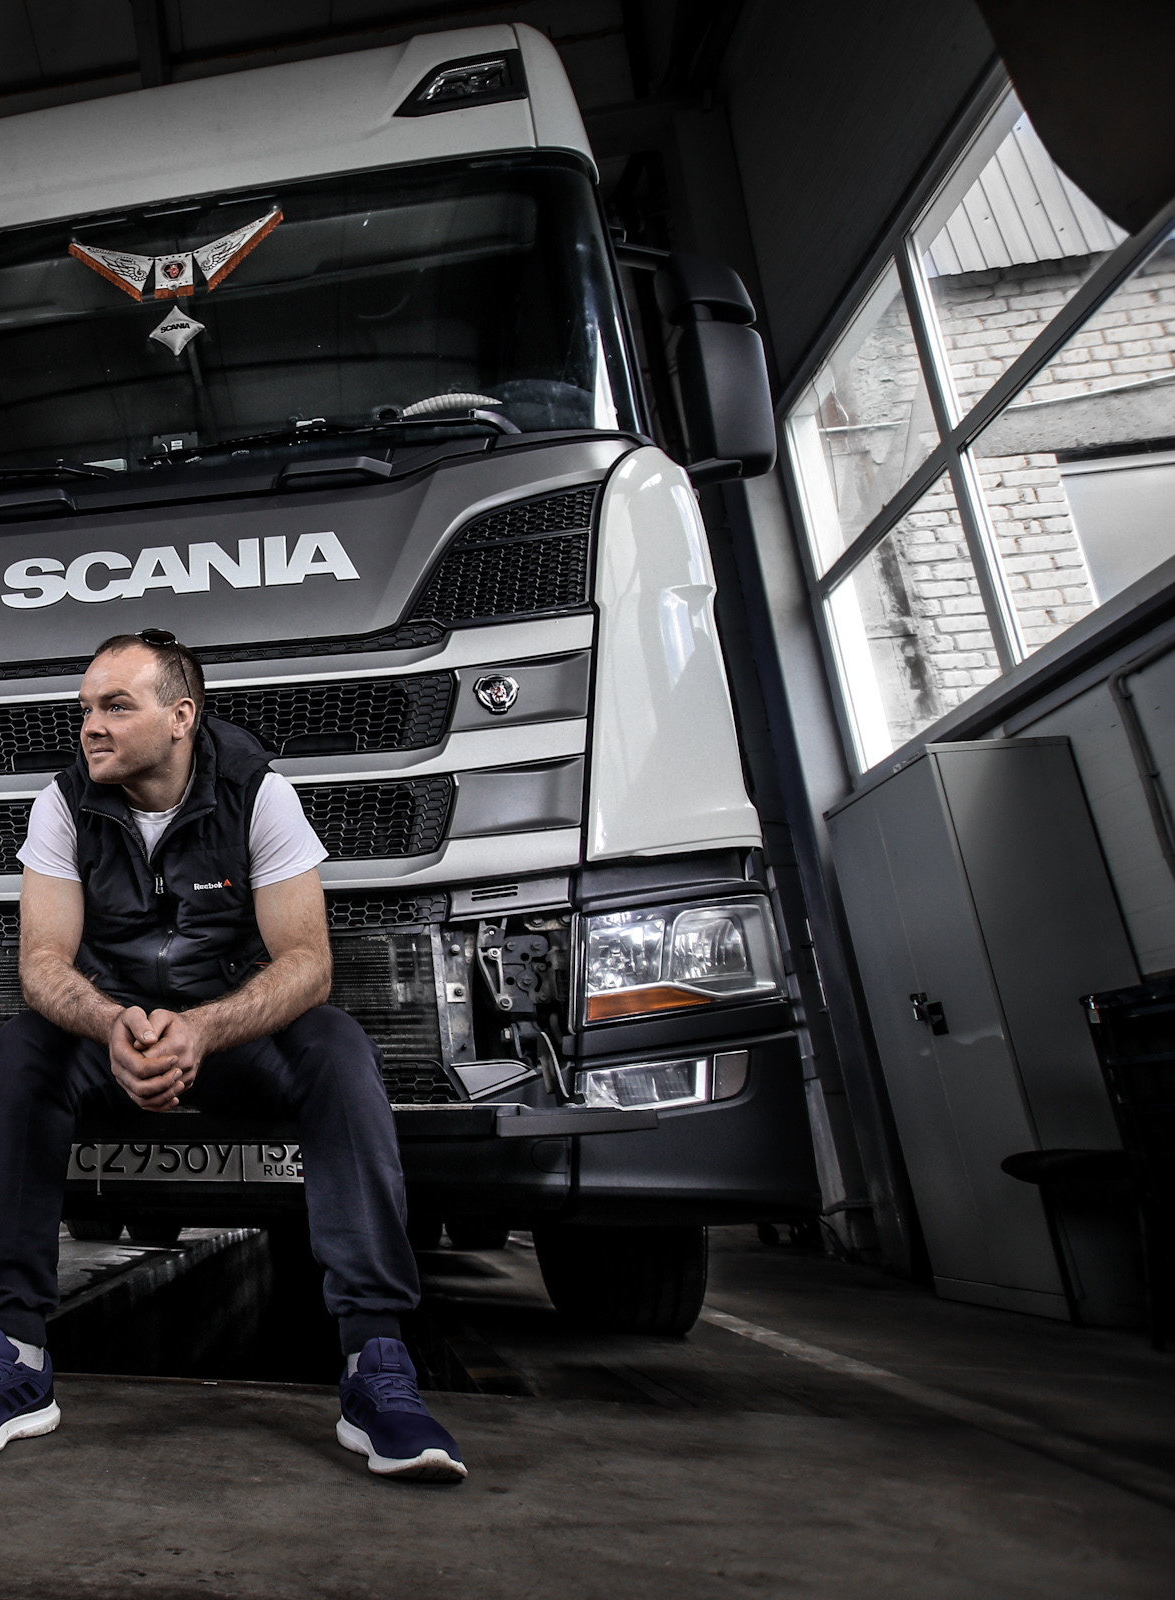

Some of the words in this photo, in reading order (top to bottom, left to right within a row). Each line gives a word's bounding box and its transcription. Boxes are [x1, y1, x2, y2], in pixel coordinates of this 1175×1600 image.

[160, 322, 191, 334] SCANIA
[0, 531, 361, 610] SCANIA
[193, 881, 223, 891] Reebok
[263, 1164, 295, 1177] RUS
